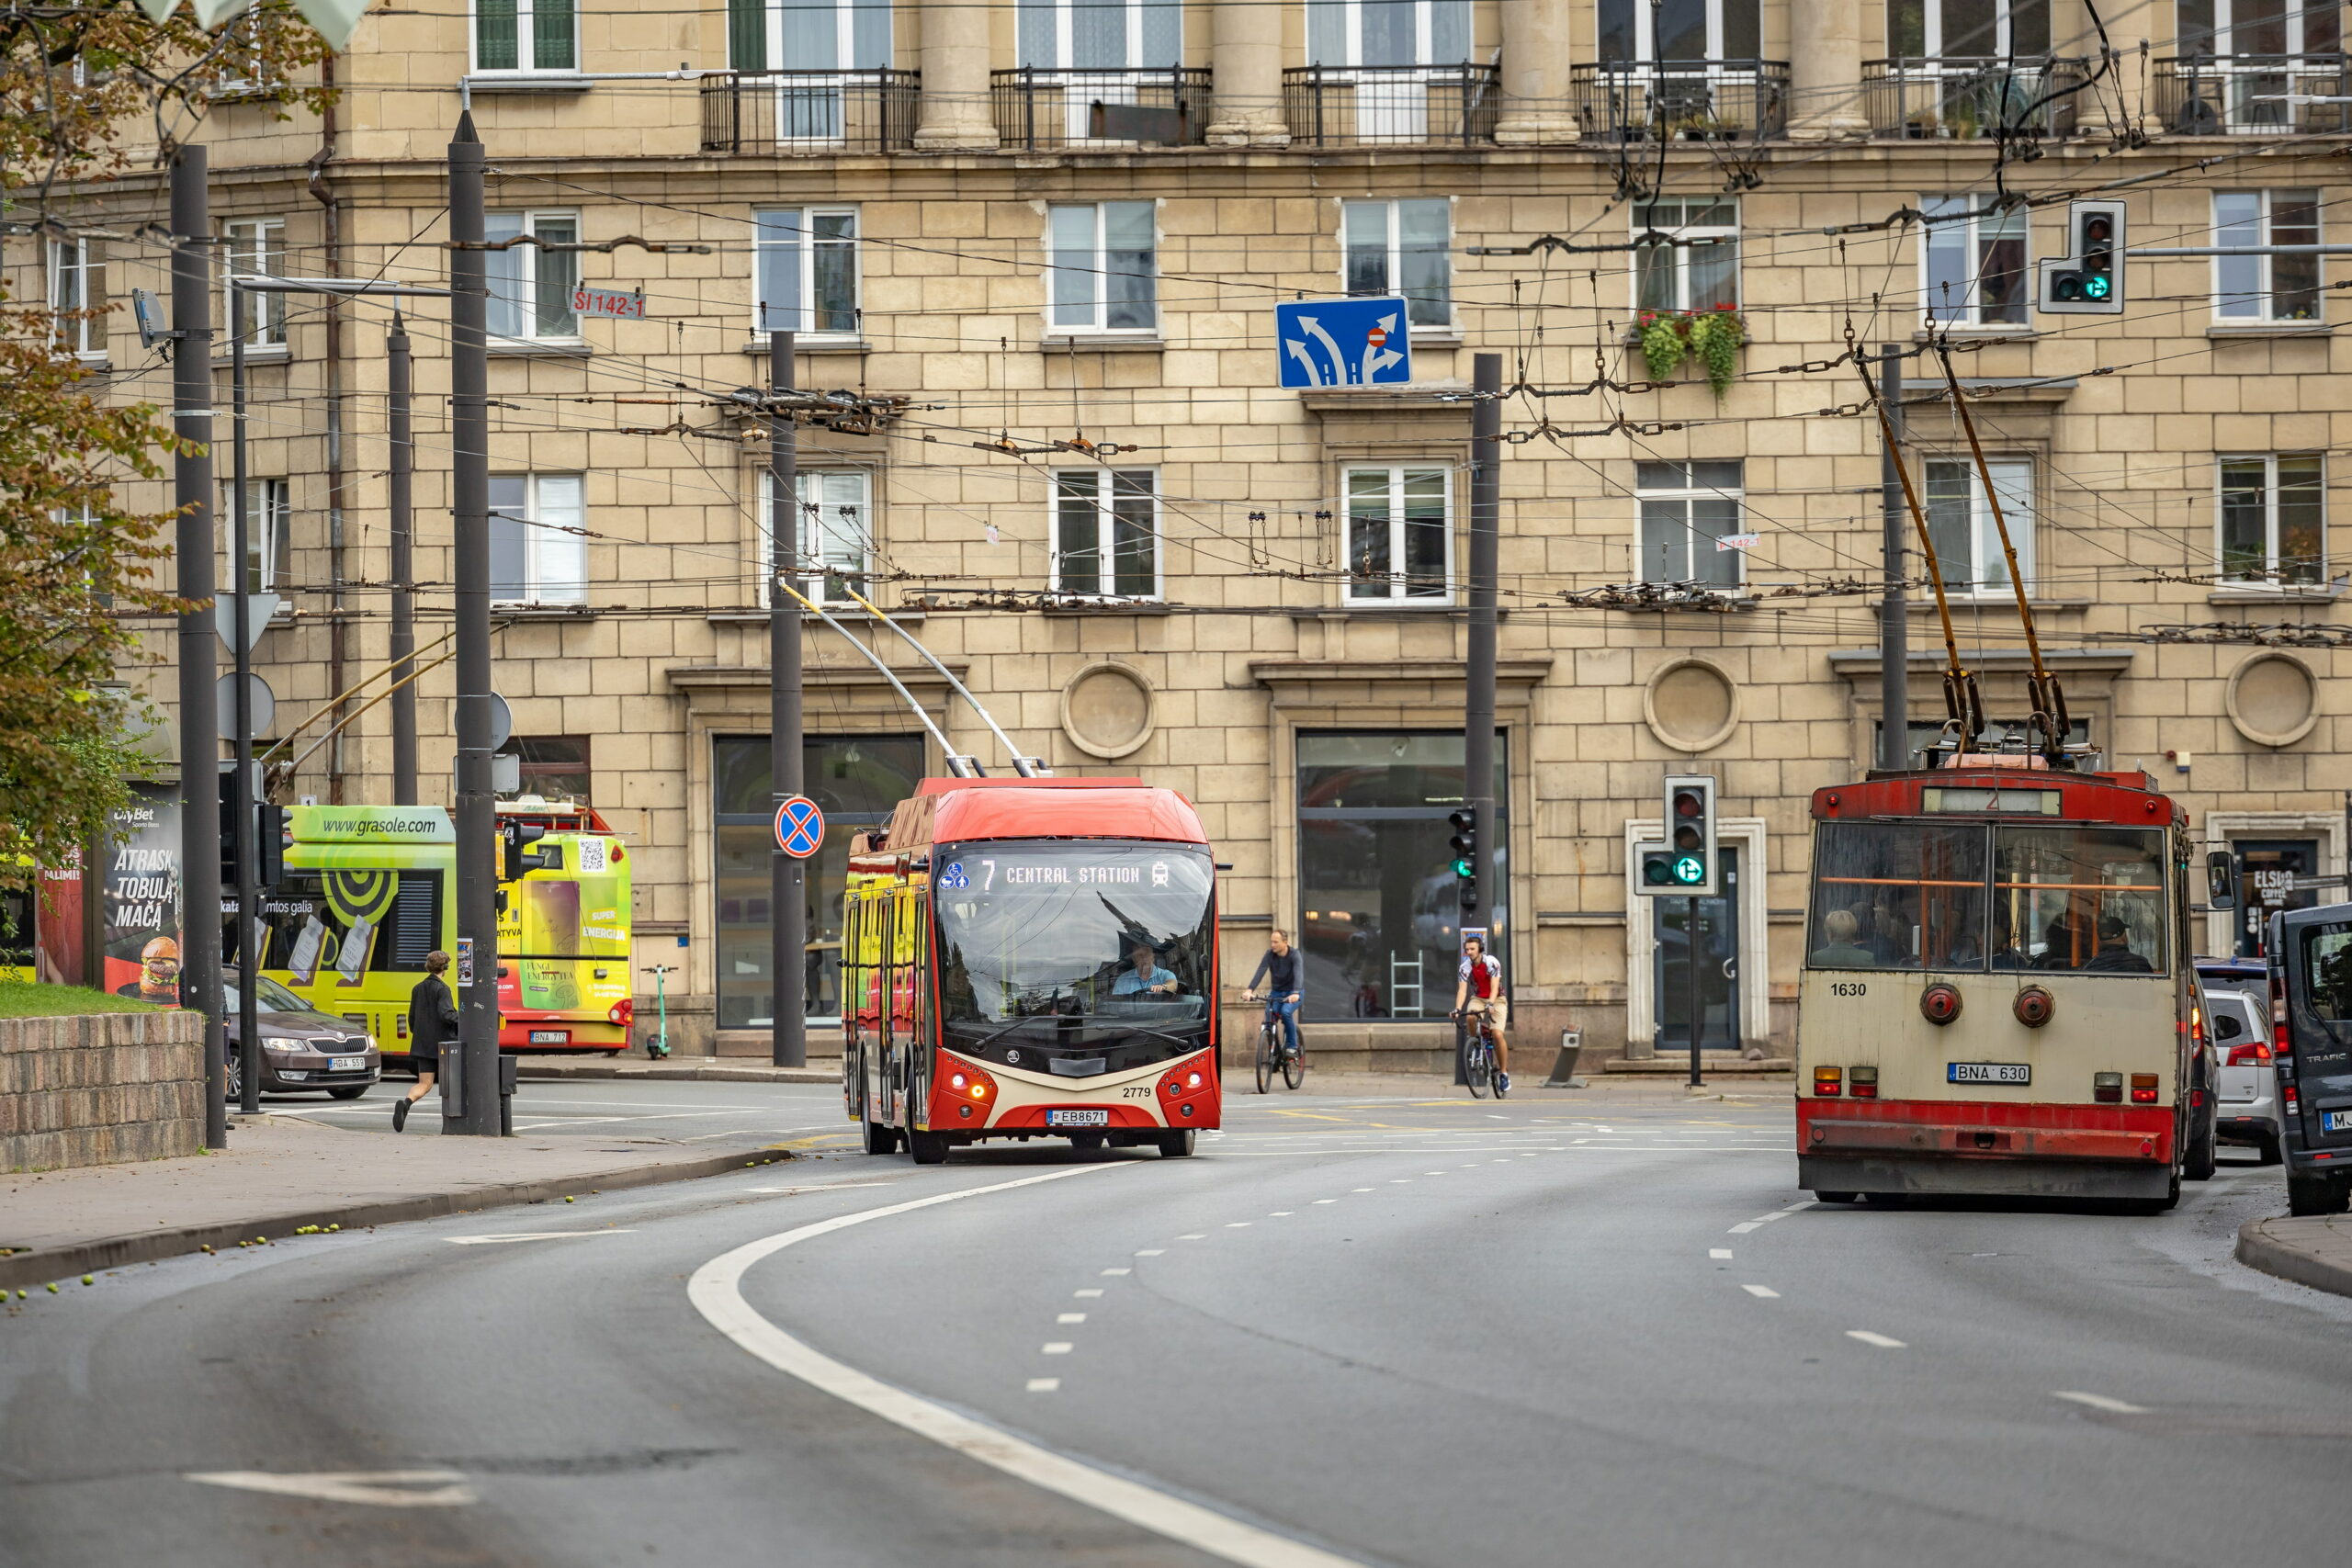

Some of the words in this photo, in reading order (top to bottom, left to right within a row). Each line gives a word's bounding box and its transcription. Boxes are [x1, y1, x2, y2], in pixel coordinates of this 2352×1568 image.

[595, 294, 643, 317] 142-1
[323, 817, 435, 837] www.grasole.com
[114, 849, 174, 872] ATRASK
[982, 860, 995, 891] 7
[1007, 867, 1070, 883] CENTRAL
[1080, 867, 1139, 883] STATION
[118, 877, 172, 903] TOBULĄ
[115, 900, 161, 931] MAČĄ
[266, 901, 288, 913] mtos
[290, 901, 313, 916] galia
[592, 910, 616, 920] SUPER
[497, 929, 522, 937] ATYVA
[582, 926, 626, 941] ENERGIJA
[526, 962, 550, 970] FUNGI
[1831, 983, 1867, 997] 1630
[535, 1032, 549, 1042] BNA
[553, 1032, 566, 1043] 712
[352, 1058, 364, 1066] 559
[2306, 1053, 2347, 1063] TRAFIC
[1958, 1066, 1990, 1079] BNA
[1999, 1066, 2027, 1080] 630
[1123, 1088, 1151, 1098] 2779
[1062, 1111, 1104, 1122] EB8671
